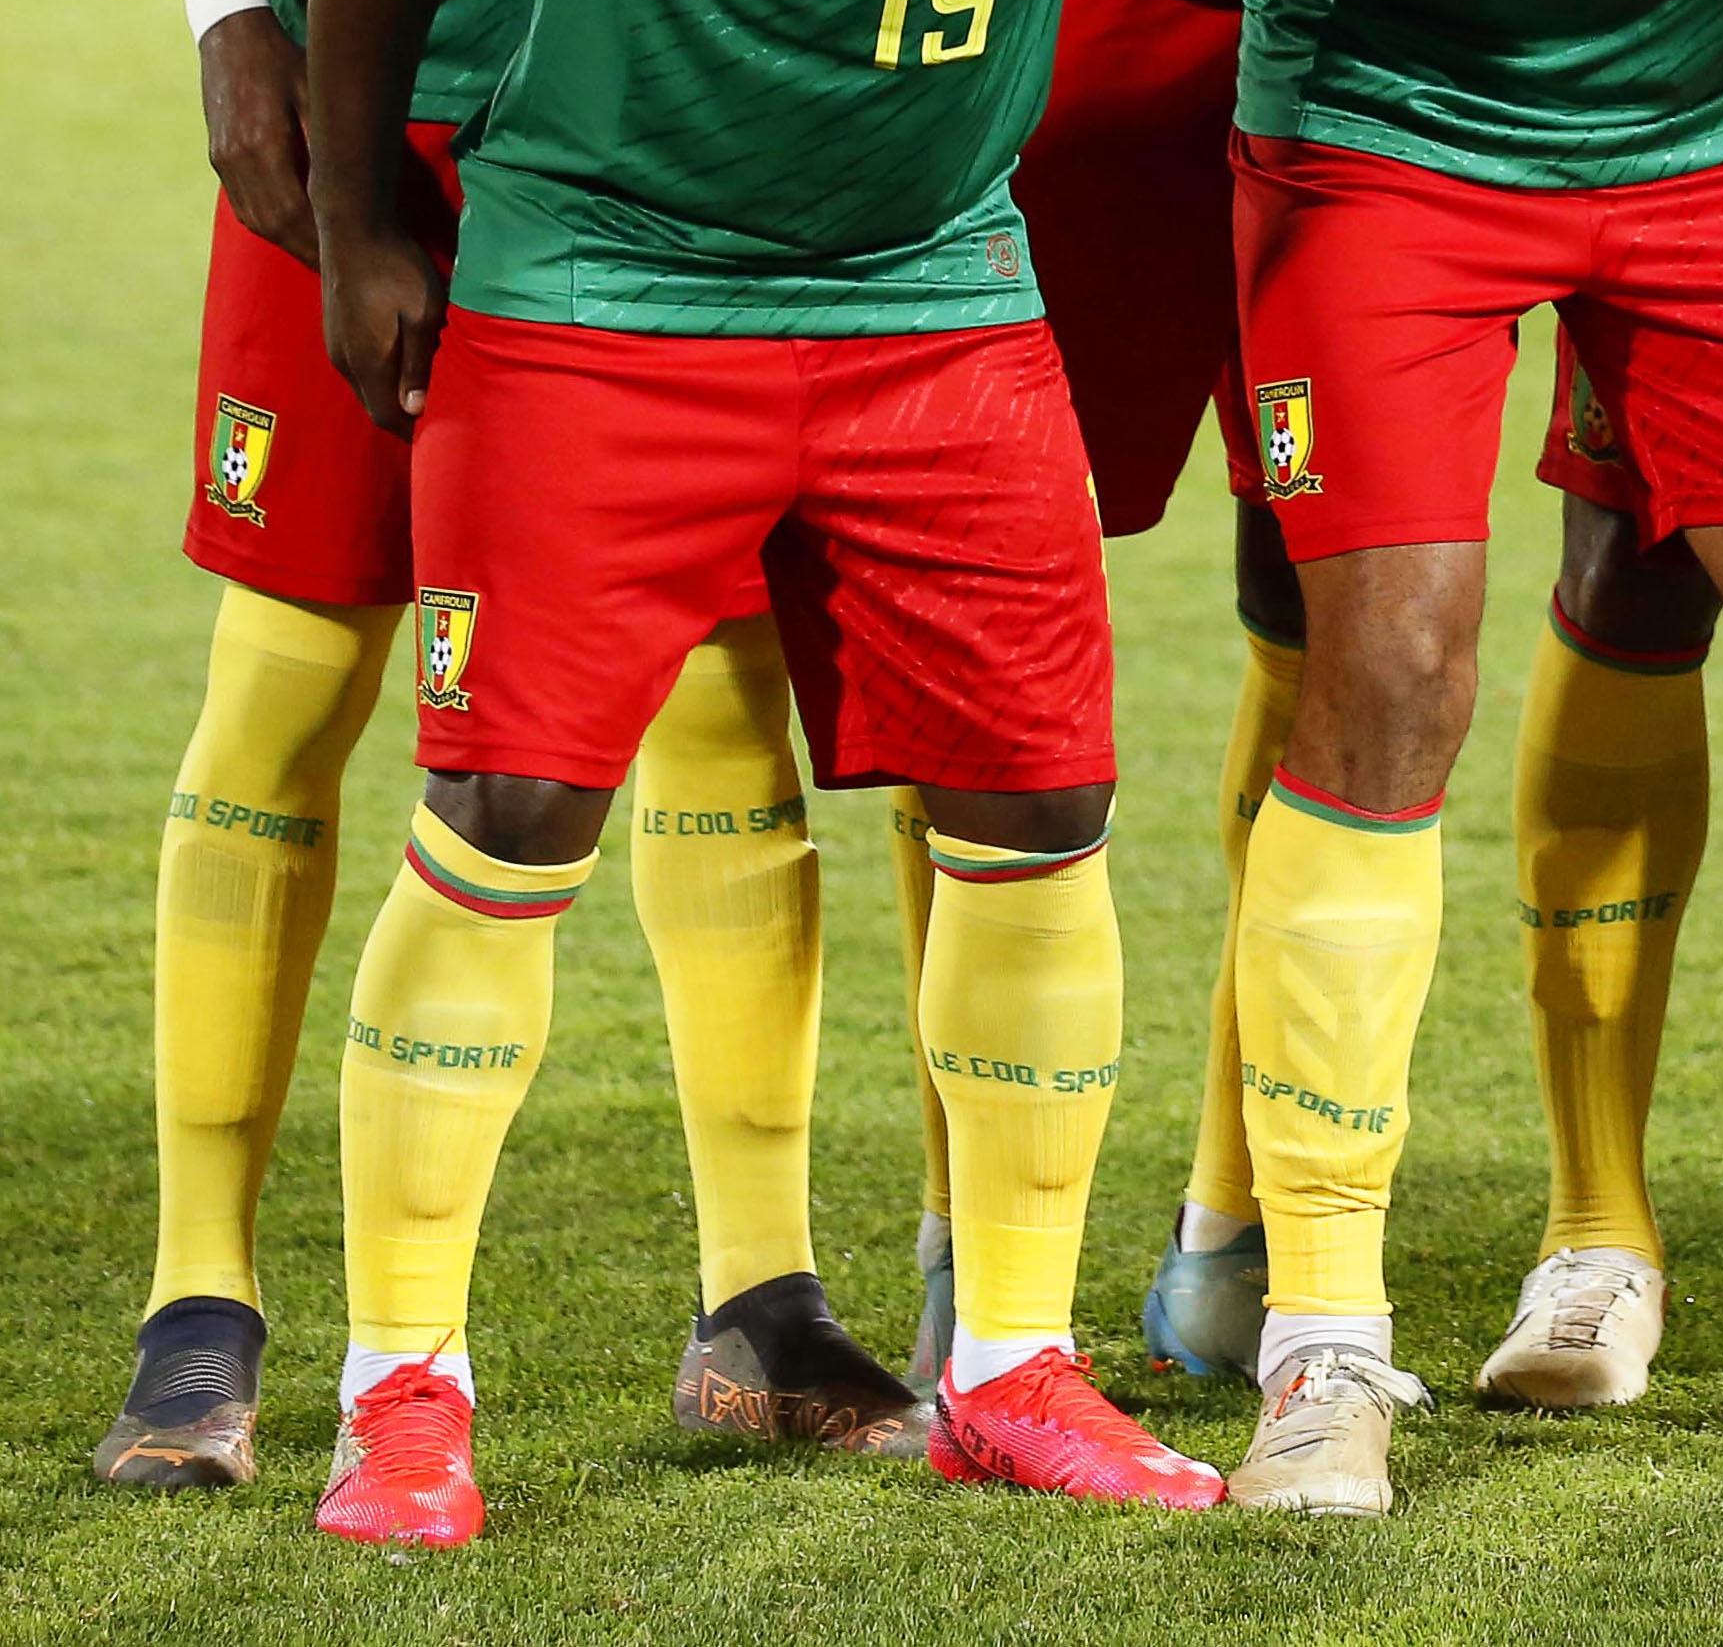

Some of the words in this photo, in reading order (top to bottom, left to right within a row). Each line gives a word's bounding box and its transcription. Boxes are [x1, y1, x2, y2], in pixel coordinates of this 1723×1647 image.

[423, 592, 473, 610] CAMEROUN
[206, 800, 325, 848] SPORTIF
[643, 808, 668, 834] LE
[678, 811, 740, 835] COQ
[1551, 893, 1680, 928] SPORTIF
[390, 1037, 524, 1070] SPORTIF
[932, 1047, 960, 1073] LE
[970, 1057, 1040, 1086] COQ
[1259, 1072, 1394, 1134] SPORTIF
